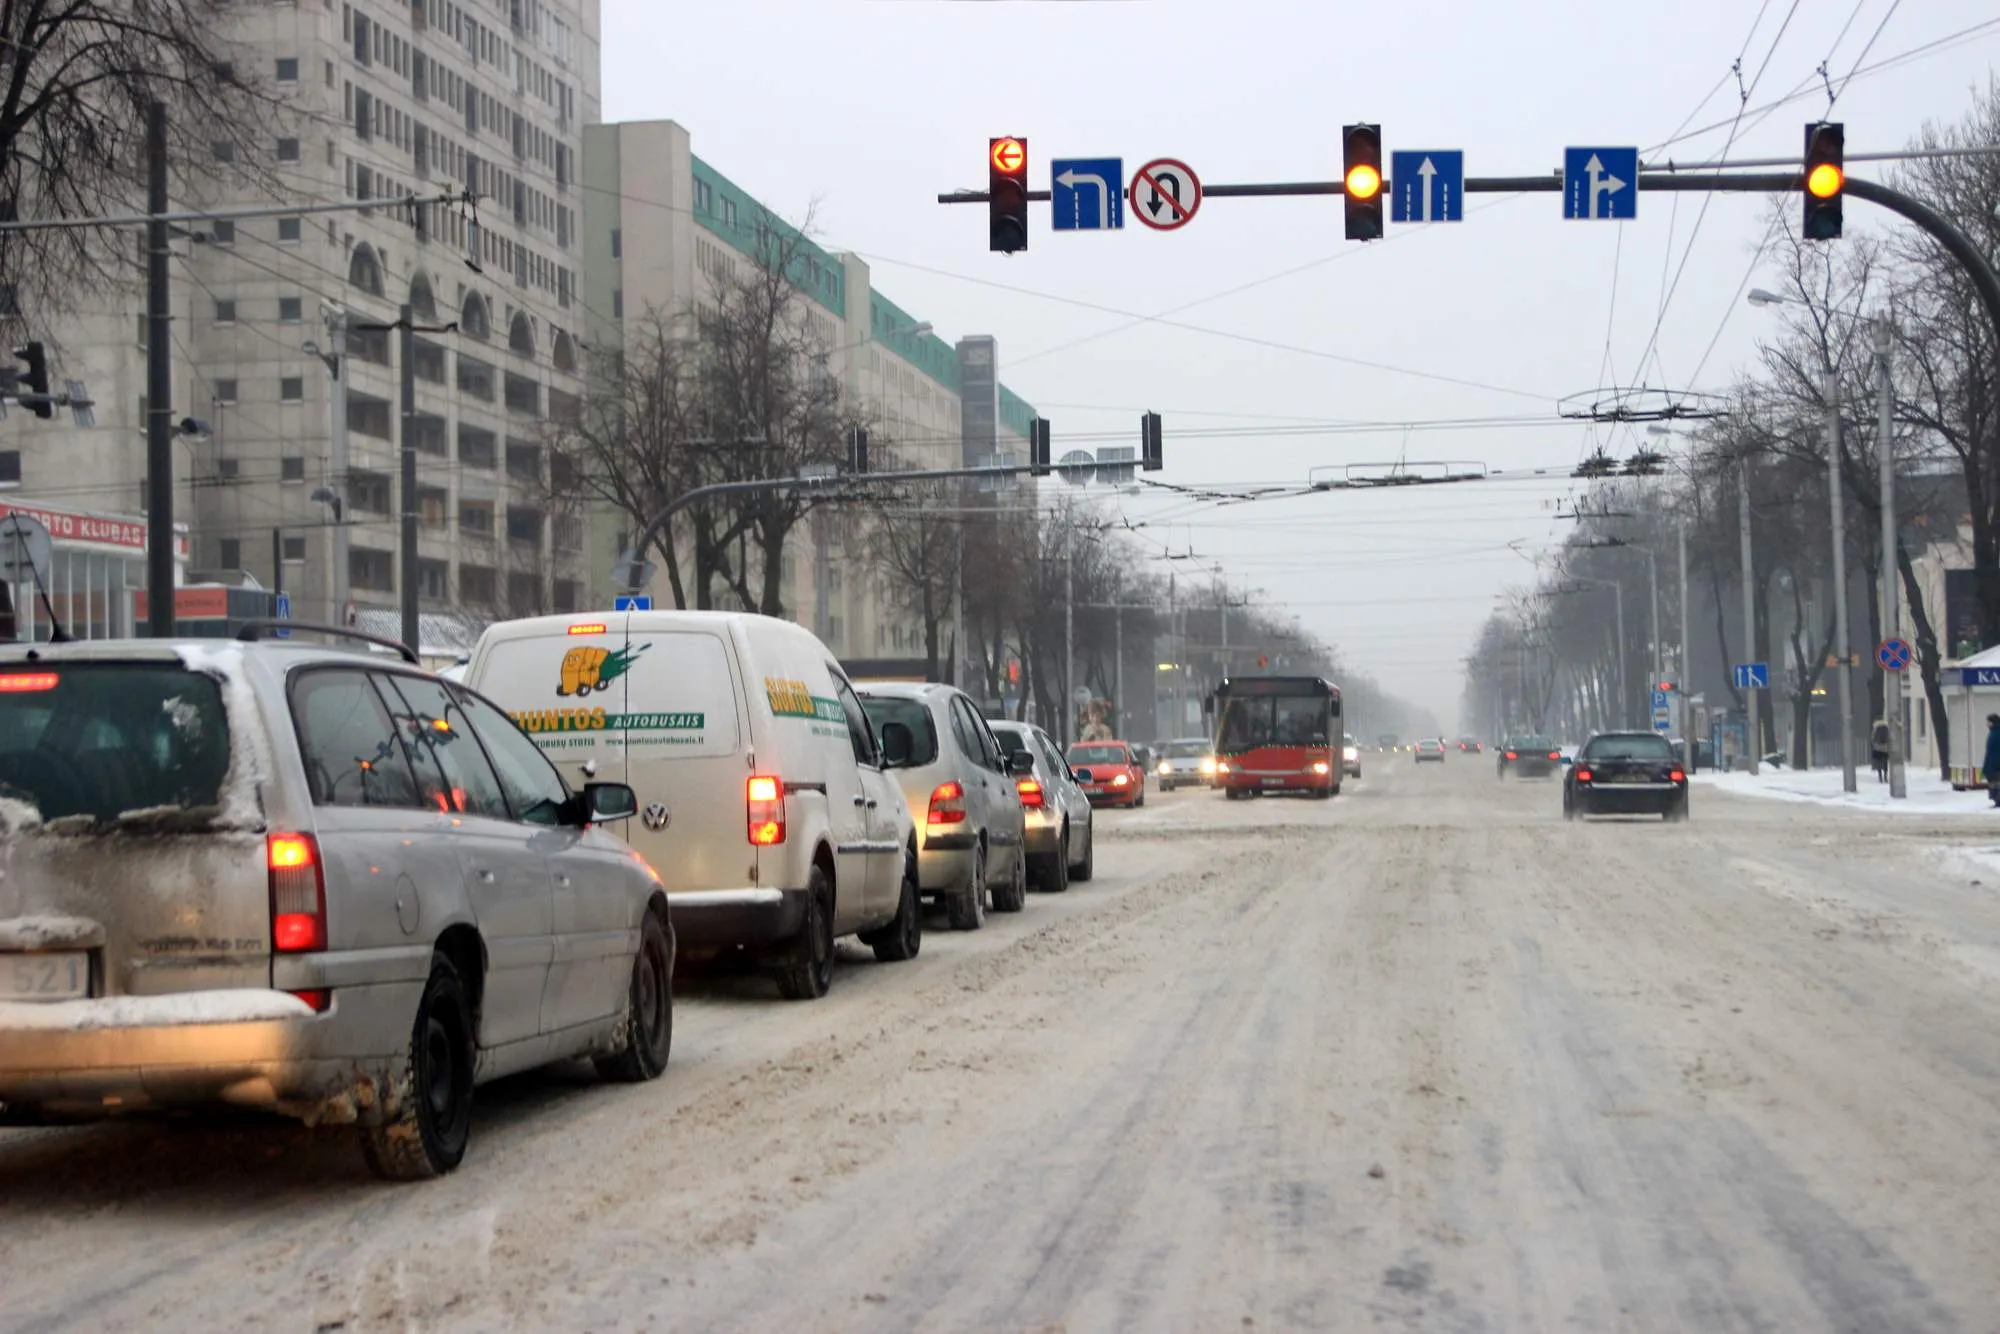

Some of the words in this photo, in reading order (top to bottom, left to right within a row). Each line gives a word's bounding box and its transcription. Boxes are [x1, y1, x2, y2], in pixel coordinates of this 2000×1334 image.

[81, 519, 141, 544] KLUBAS
[613, 714, 700, 729] AUTOBUSAIS
[13, 957, 79, 994] 521
